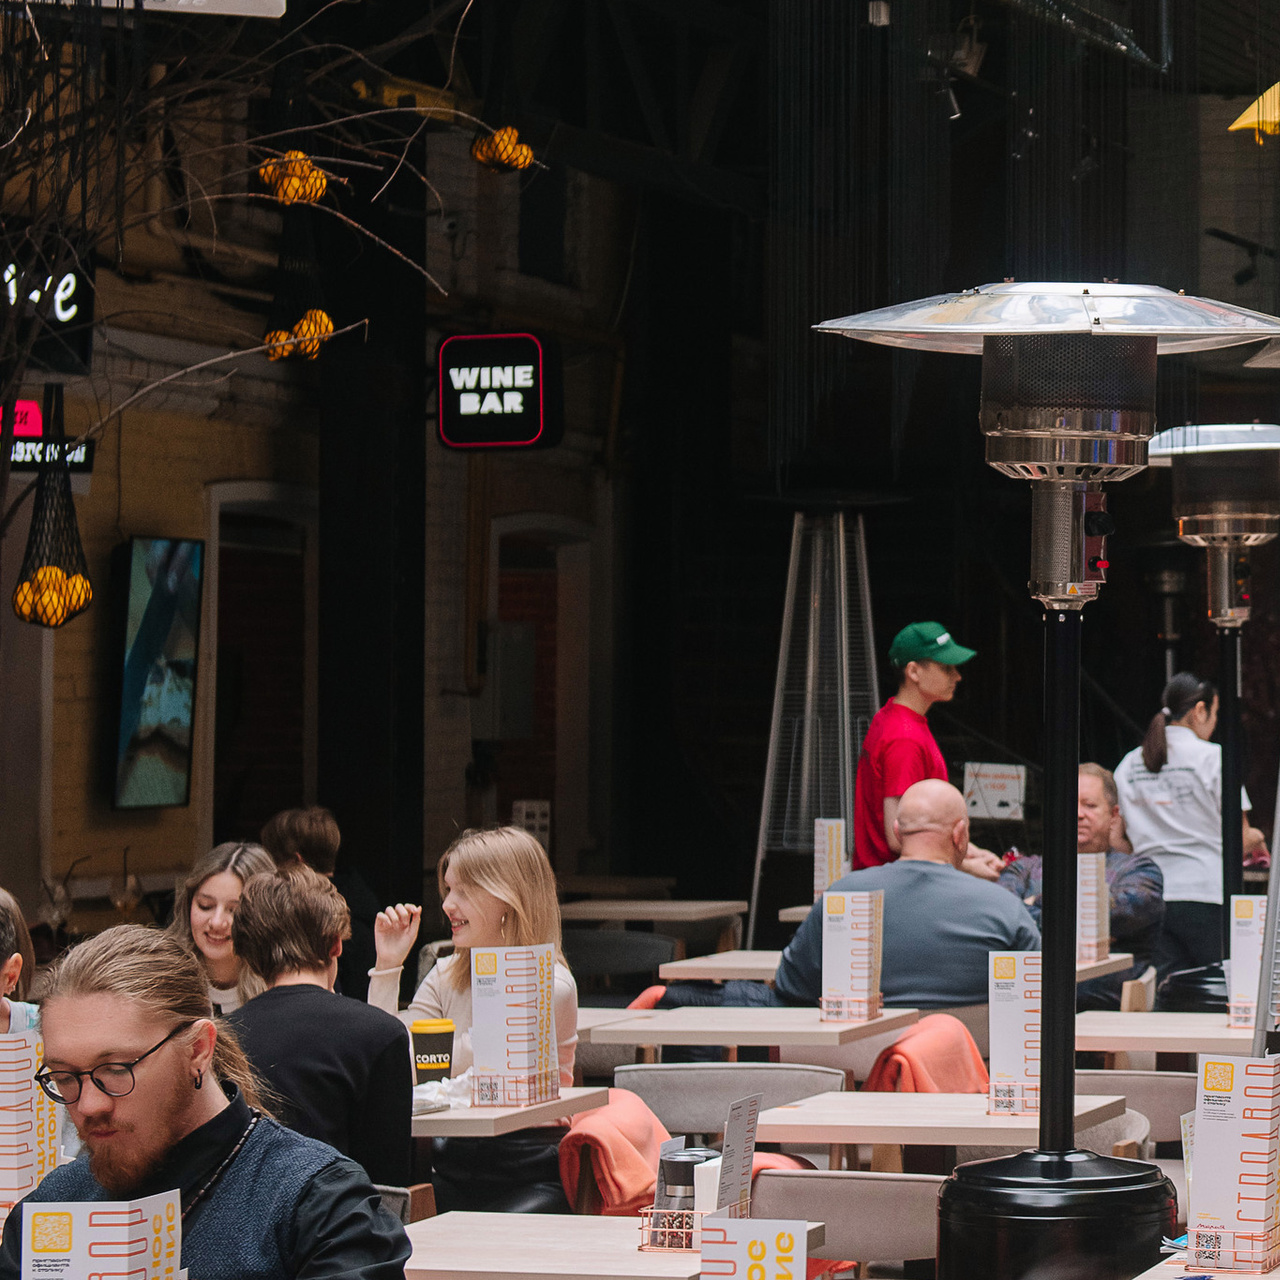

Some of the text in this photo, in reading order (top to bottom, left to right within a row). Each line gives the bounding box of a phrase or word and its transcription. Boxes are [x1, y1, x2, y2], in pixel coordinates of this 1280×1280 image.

[449, 365, 534, 390] WINE
[459, 391, 524, 415] BAR
[416, 1053, 450, 1063] CORTO
